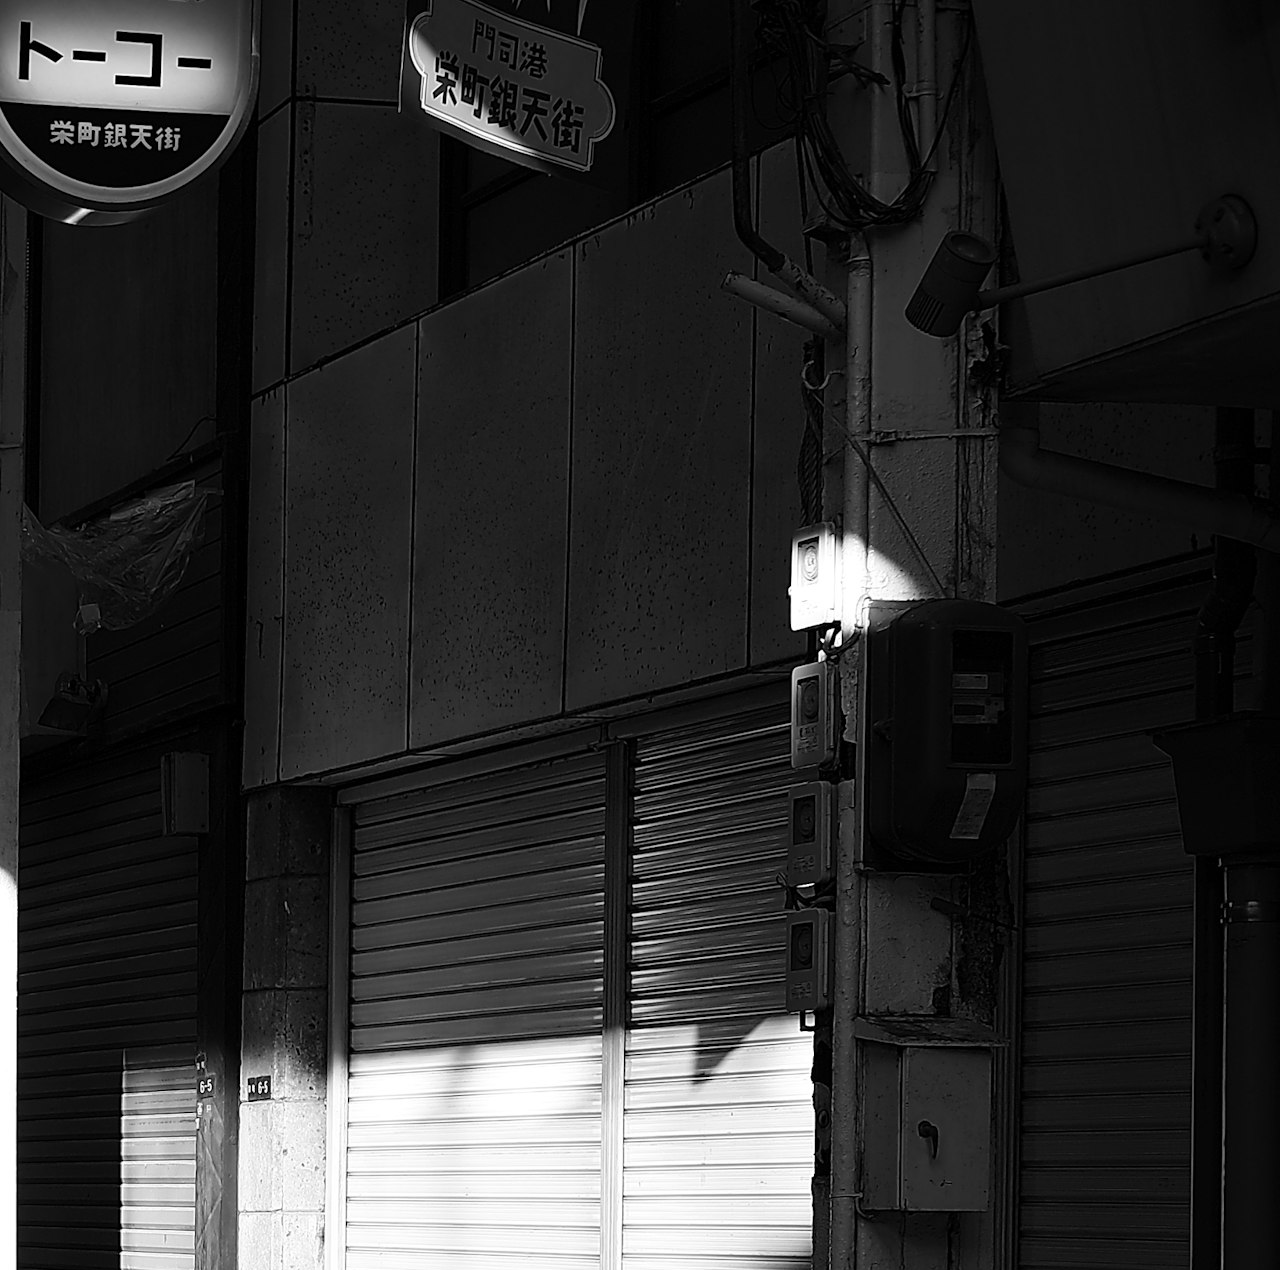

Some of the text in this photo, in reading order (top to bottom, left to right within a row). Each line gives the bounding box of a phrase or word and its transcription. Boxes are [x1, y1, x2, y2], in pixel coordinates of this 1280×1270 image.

[18, 21, 212, 87] トーコー
[473, 19, 548, 79] 門司港
[433, 51, 584, 154] 栄町銀天街
[48, 119, 182, 152] 栄町銀天街
